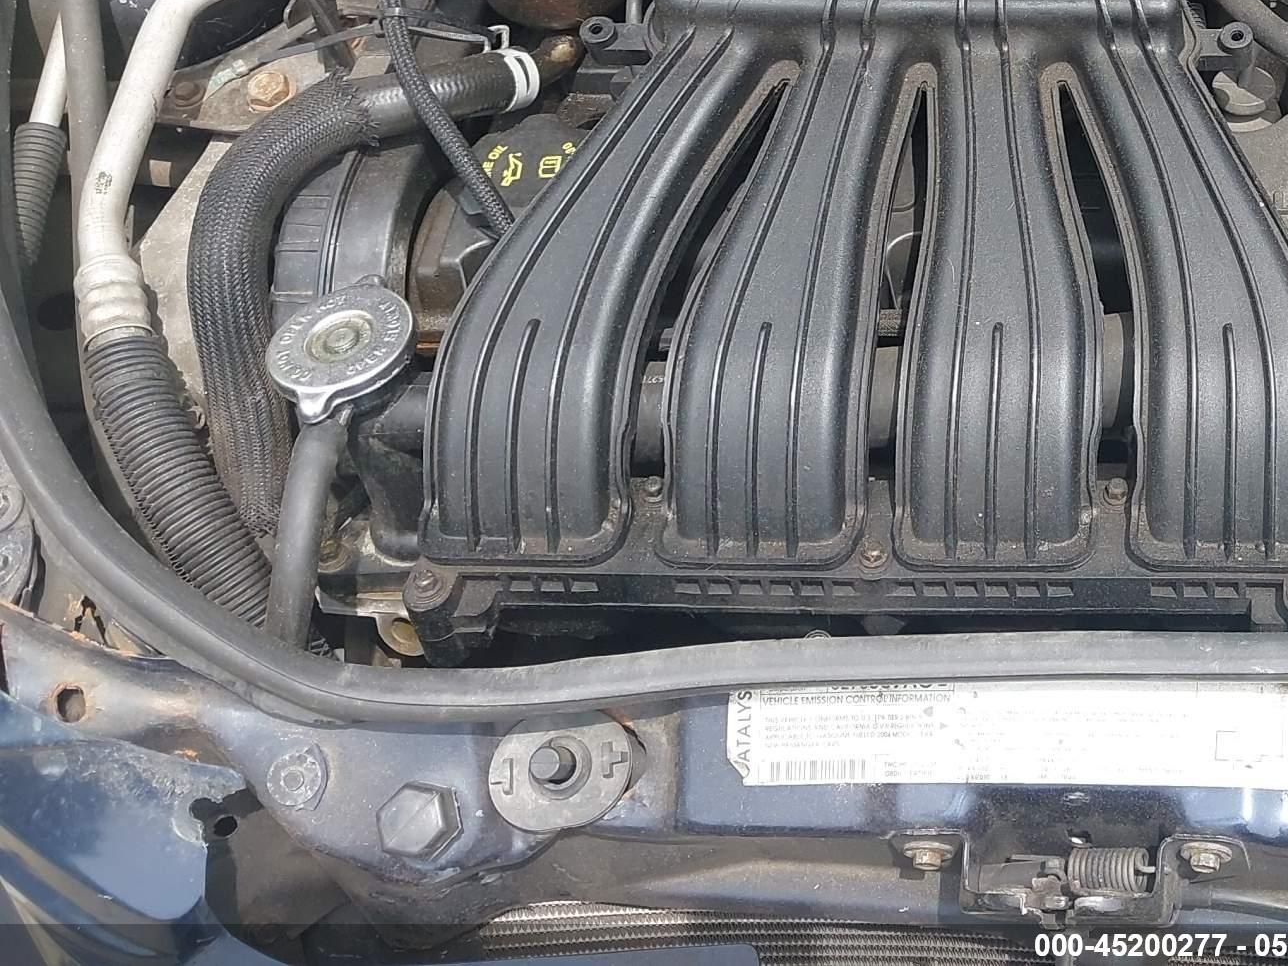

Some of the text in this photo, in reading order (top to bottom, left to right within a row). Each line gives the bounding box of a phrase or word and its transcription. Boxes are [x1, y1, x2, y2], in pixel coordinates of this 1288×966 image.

[488, 144, 509, 160] OIL
[379, 299, 402, 342] SLOWLY
[762, 693, 950, 706] VEHICLE EMISSION CONTROL INFORMATION
[736, 690, 752, 780] CATALYS
